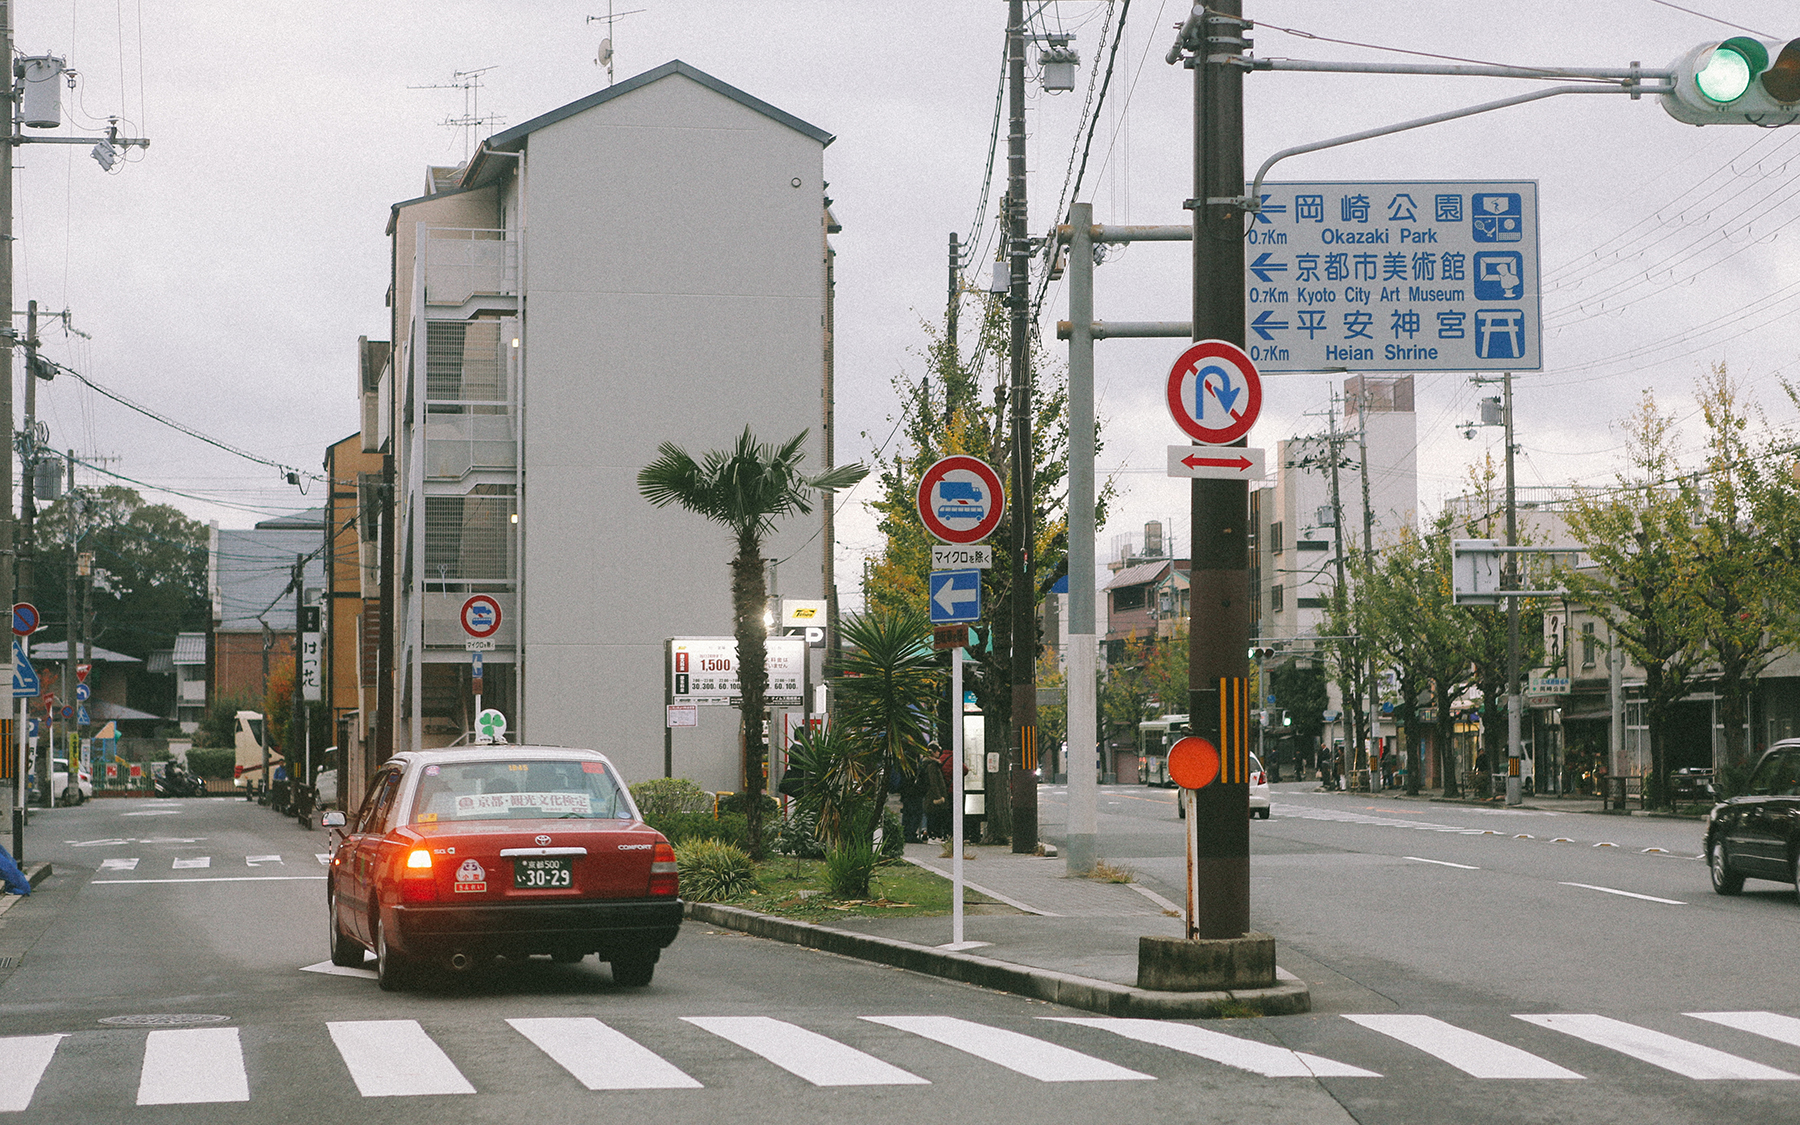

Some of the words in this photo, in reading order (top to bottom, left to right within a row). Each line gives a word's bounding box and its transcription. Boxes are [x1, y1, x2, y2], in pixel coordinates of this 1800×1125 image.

[1295, 193, 1463, 223] 岡崎公園
[1248, 229, 1288, 245] 0.7Km
[1321, 228, 1389, 244] Okazaki
[1400, 228, 1438, 243] Park
[1296, 251, 1466, 281] 京都市美術館
[1250, 287, 1289, 303] 0.7Km
[1297, 287, 1336, 306] Kyoto
[1344, 286, 1371, 306] City
[1380, 286, 1401, 302] Art
[1408, 286, 1465, 302] Museum
[1296, 309, 1466, 340] 平安神宮
[1250, 345, 1290, 361] 0.7Km
[1325, 345, 1374, 361] Heian
[1384, 344, 1438, 360] Shrine
[934, 551, 991, 565] マイクロを除く
[805, 627, 824, 643] P
[302, 641, 320, 688] はつ花
[526, 869, 570, 886] 30-29
